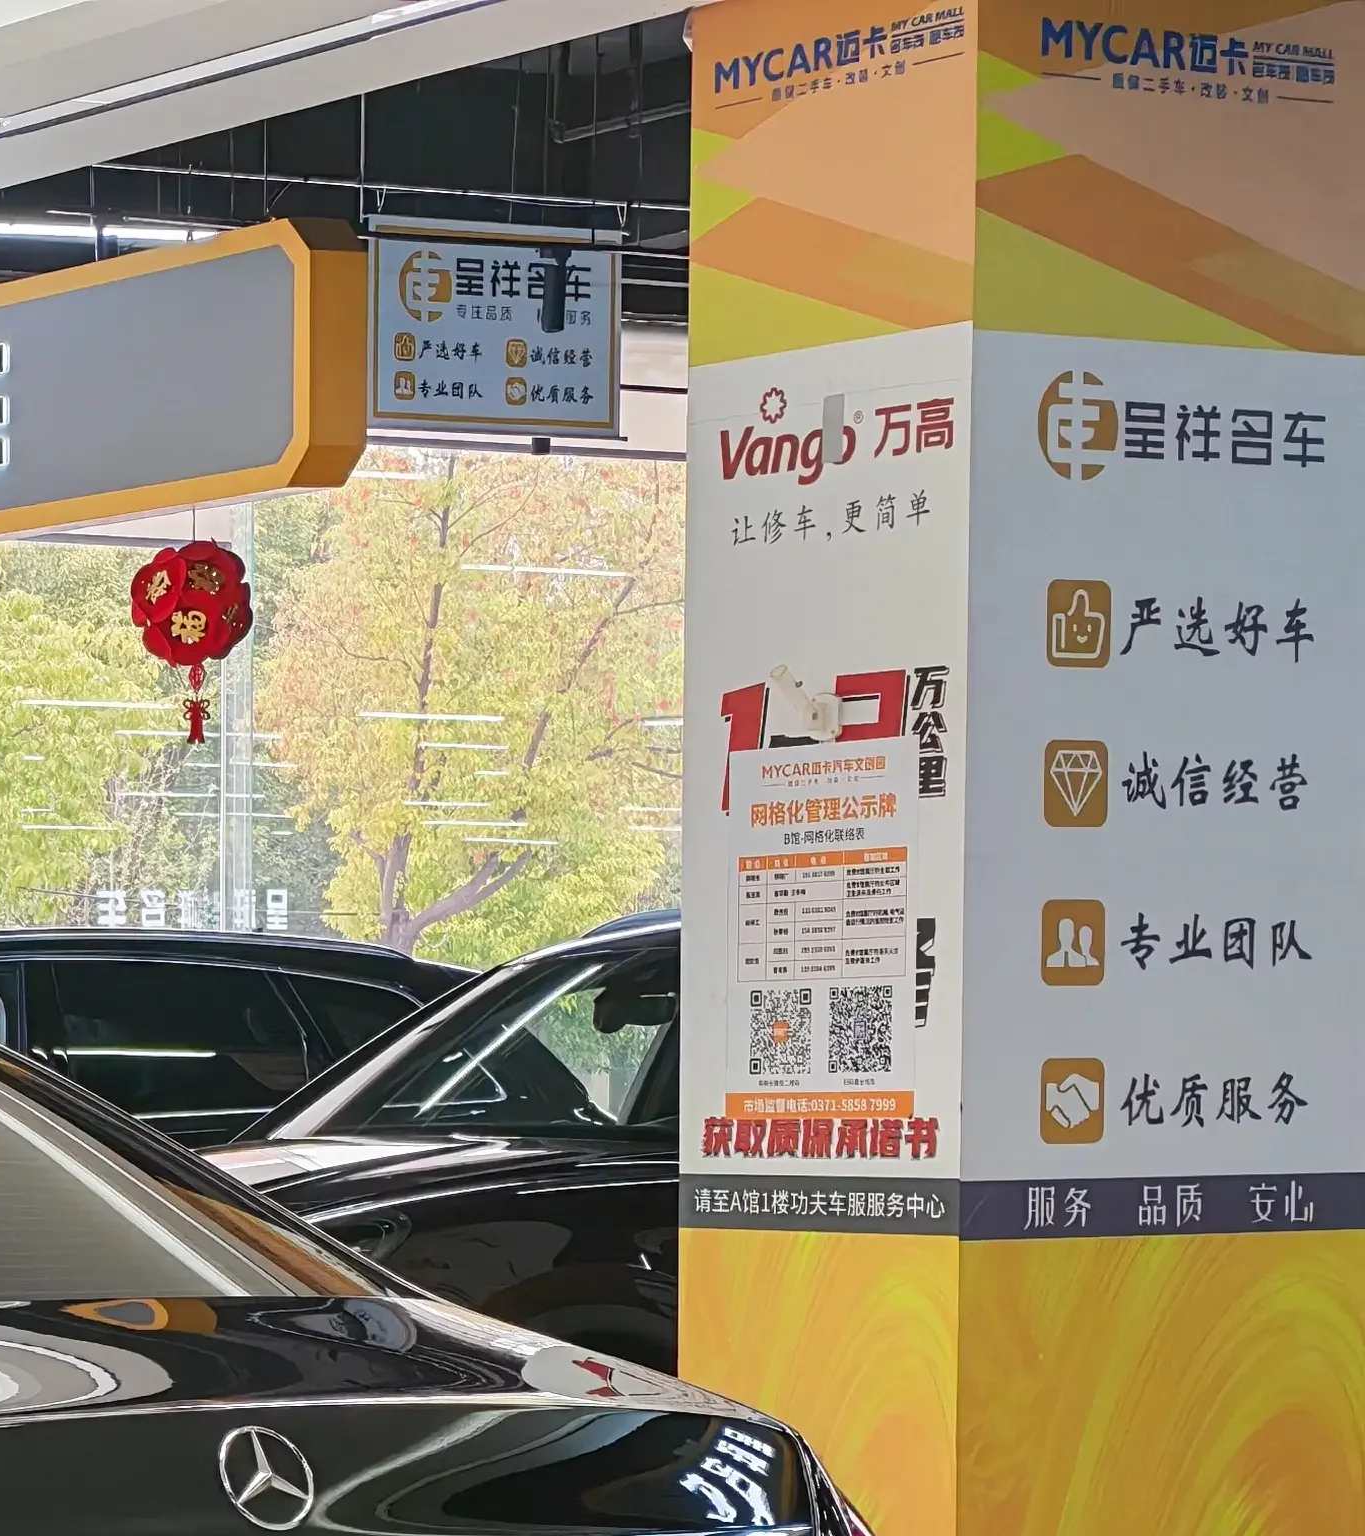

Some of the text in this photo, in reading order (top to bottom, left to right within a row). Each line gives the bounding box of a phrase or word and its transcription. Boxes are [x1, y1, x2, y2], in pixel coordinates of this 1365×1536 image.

[418, 340, 483, 363] 严选好车
[530, 345, 593, 368] 诚信经营
[418, 380, 483, 400] 专业团队
[530, 383, 594, 405] 优质服务
[874, 397, 955, 459] 万高
[1123, 400, 1326, 468] 呈祥名车
[1119, 596, 1315, 663] 严选好车
[911, 665, 950, 799] 万公里
[1121, 751, 1309, 811] 诚信经营
[751, 792, 898, 828] 网格化管理公示牌
[1120, 912, 1312, 971] 专业团队
[1119, 1071, 1309, 1128] 优质服务
[693, 1188, 946, 1219] 请至A馆1楼功夫车服服务中心
[1024, 1180, 1314, 1230] 服务 品质 安心
